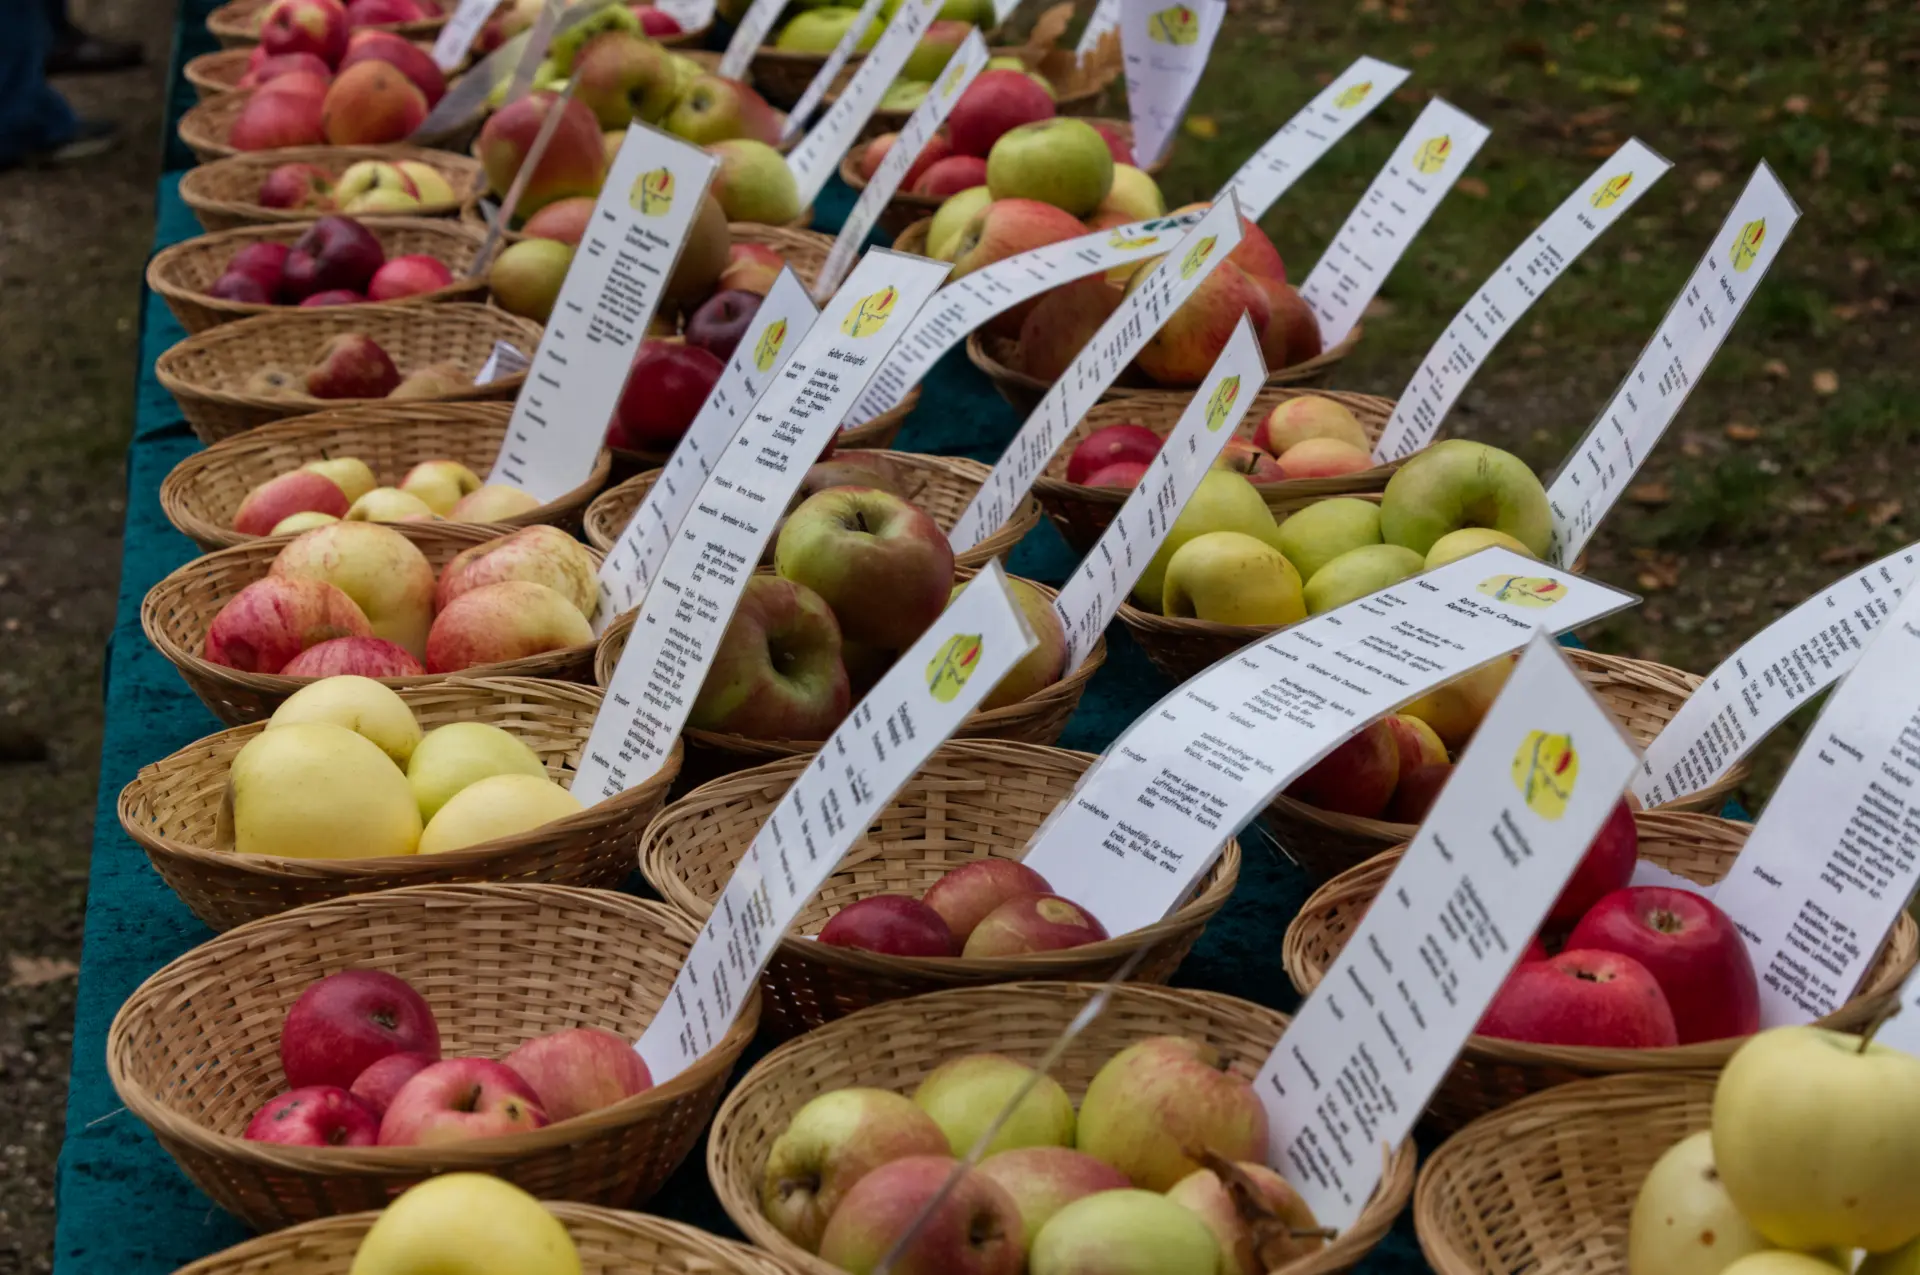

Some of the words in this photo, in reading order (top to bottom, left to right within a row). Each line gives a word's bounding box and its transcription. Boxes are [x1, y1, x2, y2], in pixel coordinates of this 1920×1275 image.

[828, 348, 844, 359] Gelber
[1416, 581, 1439, 592] Name
[1446, 603, 1478, 617] Renette
[1458, 598, 1478, 608] Rote
[1497, 614, 1531, 629] Orangen
[1400, 621, 1415, 629] Rote
[1239, 658, 1259, 669] Frucht
[1192, 740, 1212, 751] später
[1829, 735, 1863, 762] Verwendung
[1121, 747, 1146, 763] Standort
[1162, 768, 1181, 783] Warme
[1181, 780, 1199, 792] Lagen
[1210, 795, 1227, 807] hoher
[1138, 795, 1154, 808] Böden
[1078, 799, 1109, 820] Krankheiten
[1195, 813, 1217, 830] feuchte
[1109, 830, 1126, 845] Krebs,
[1160, 861, 1177, 873] etwas
[1151, 840, 1161, 849] für
[1754, 866, 1782, 887] Standort
